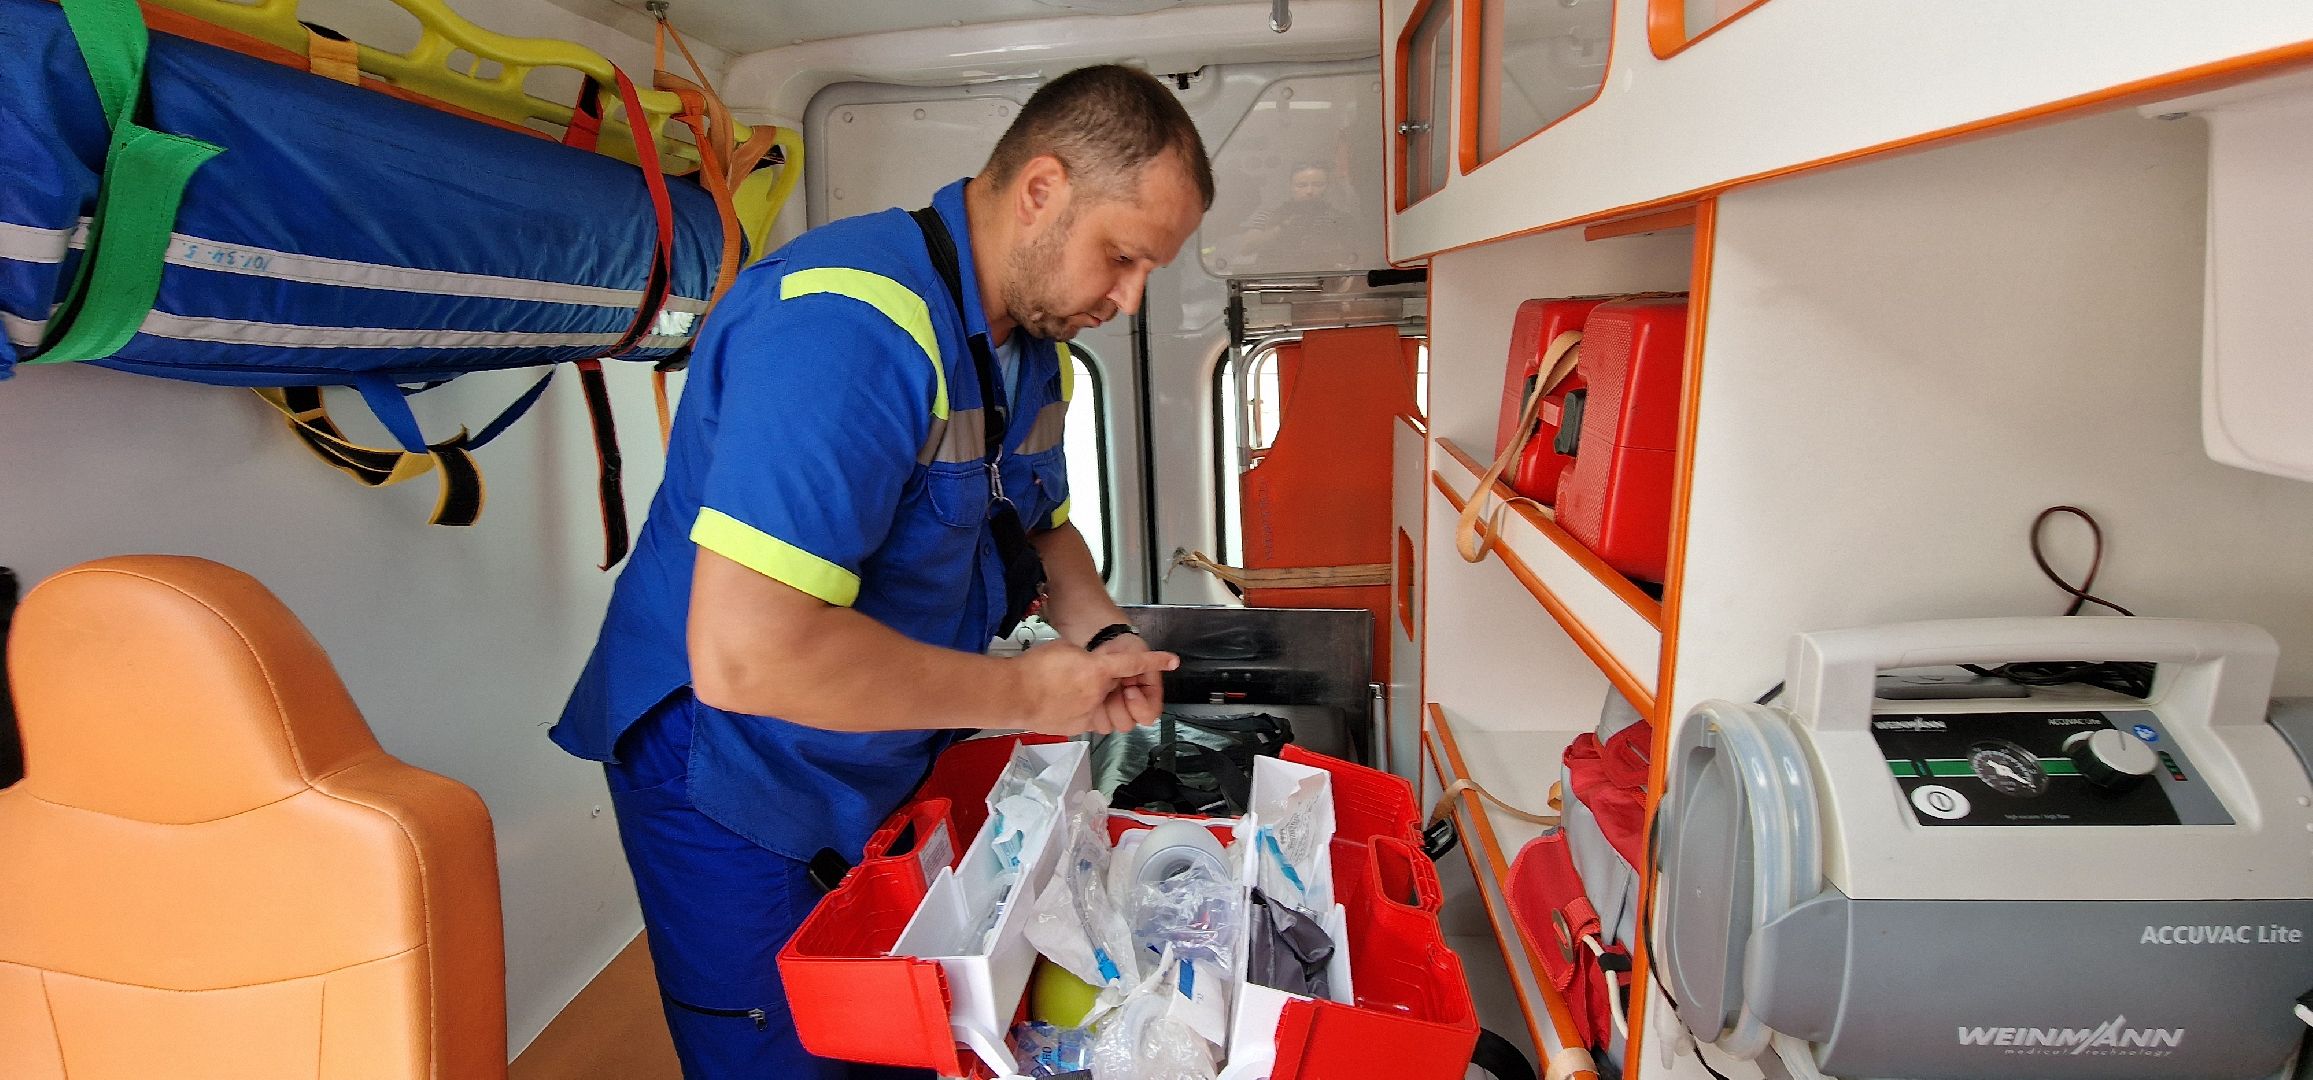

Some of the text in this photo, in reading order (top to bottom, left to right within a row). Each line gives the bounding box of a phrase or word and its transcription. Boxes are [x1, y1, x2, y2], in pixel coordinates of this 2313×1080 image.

[2140, 924, 2302, 945] ACCUVAC Lite
[1958, 1014, 2185, 1055] WEINMANN
[2004, 1047, 2173, 1058] medical technology
